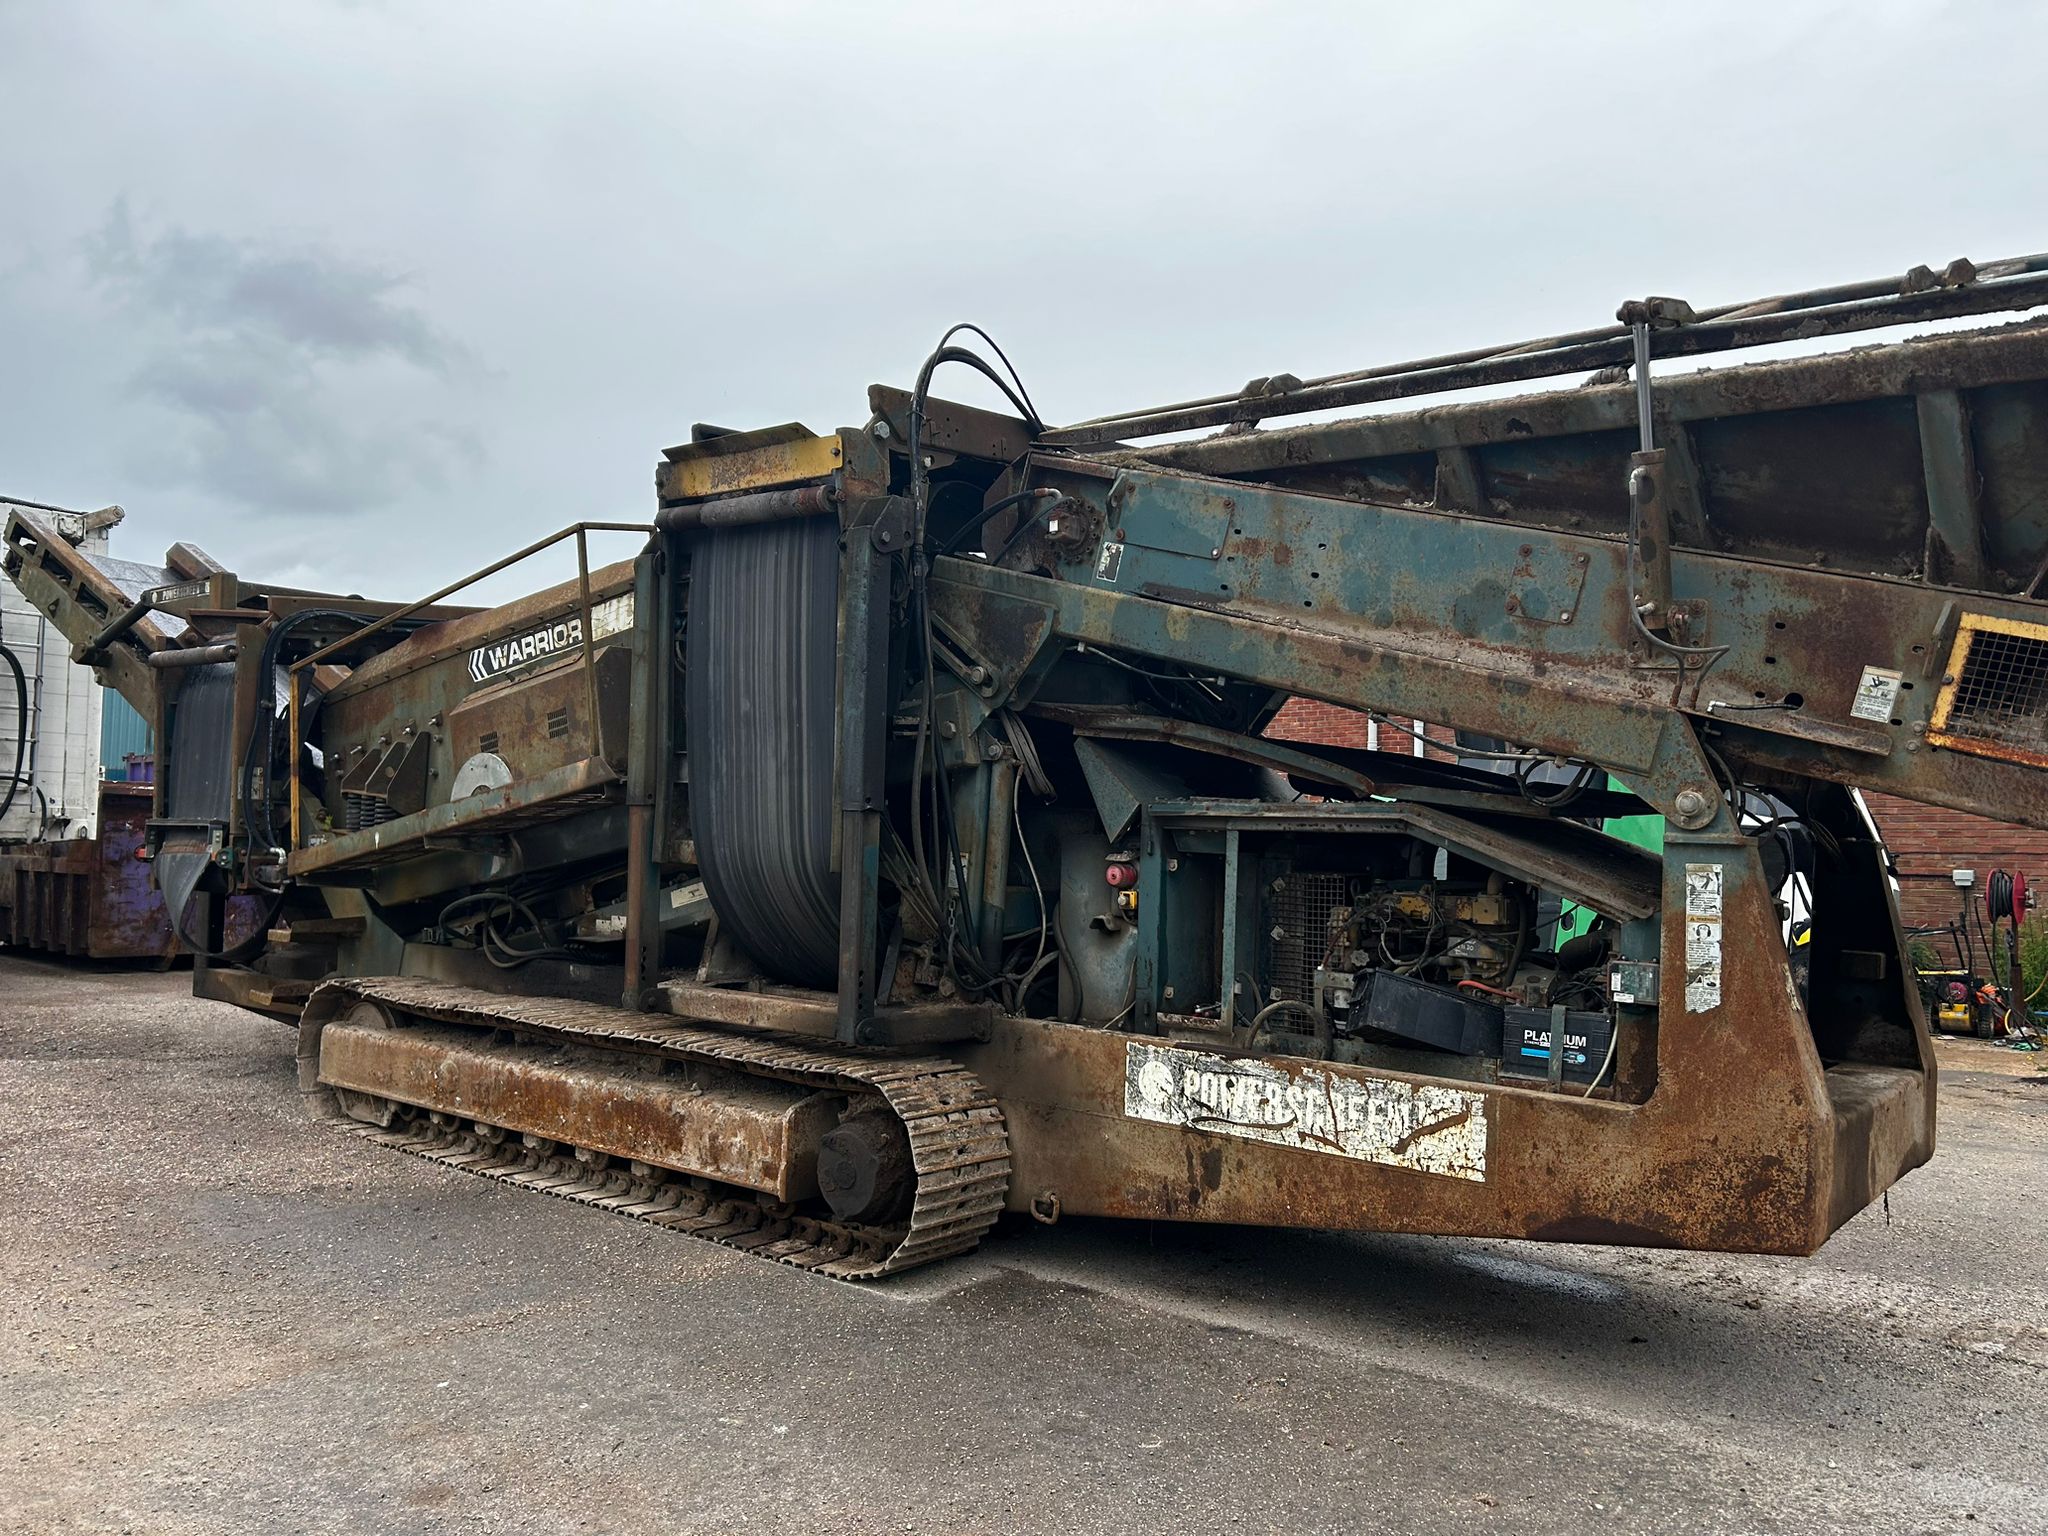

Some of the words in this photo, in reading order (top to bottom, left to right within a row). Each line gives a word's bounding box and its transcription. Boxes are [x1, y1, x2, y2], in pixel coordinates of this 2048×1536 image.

[488, 618, 583, 670] WARRIOR
[1523, 1029, 1587, 1048] PLATUM
[1183, 1066, 1410, 1139] POWERSCREEN
